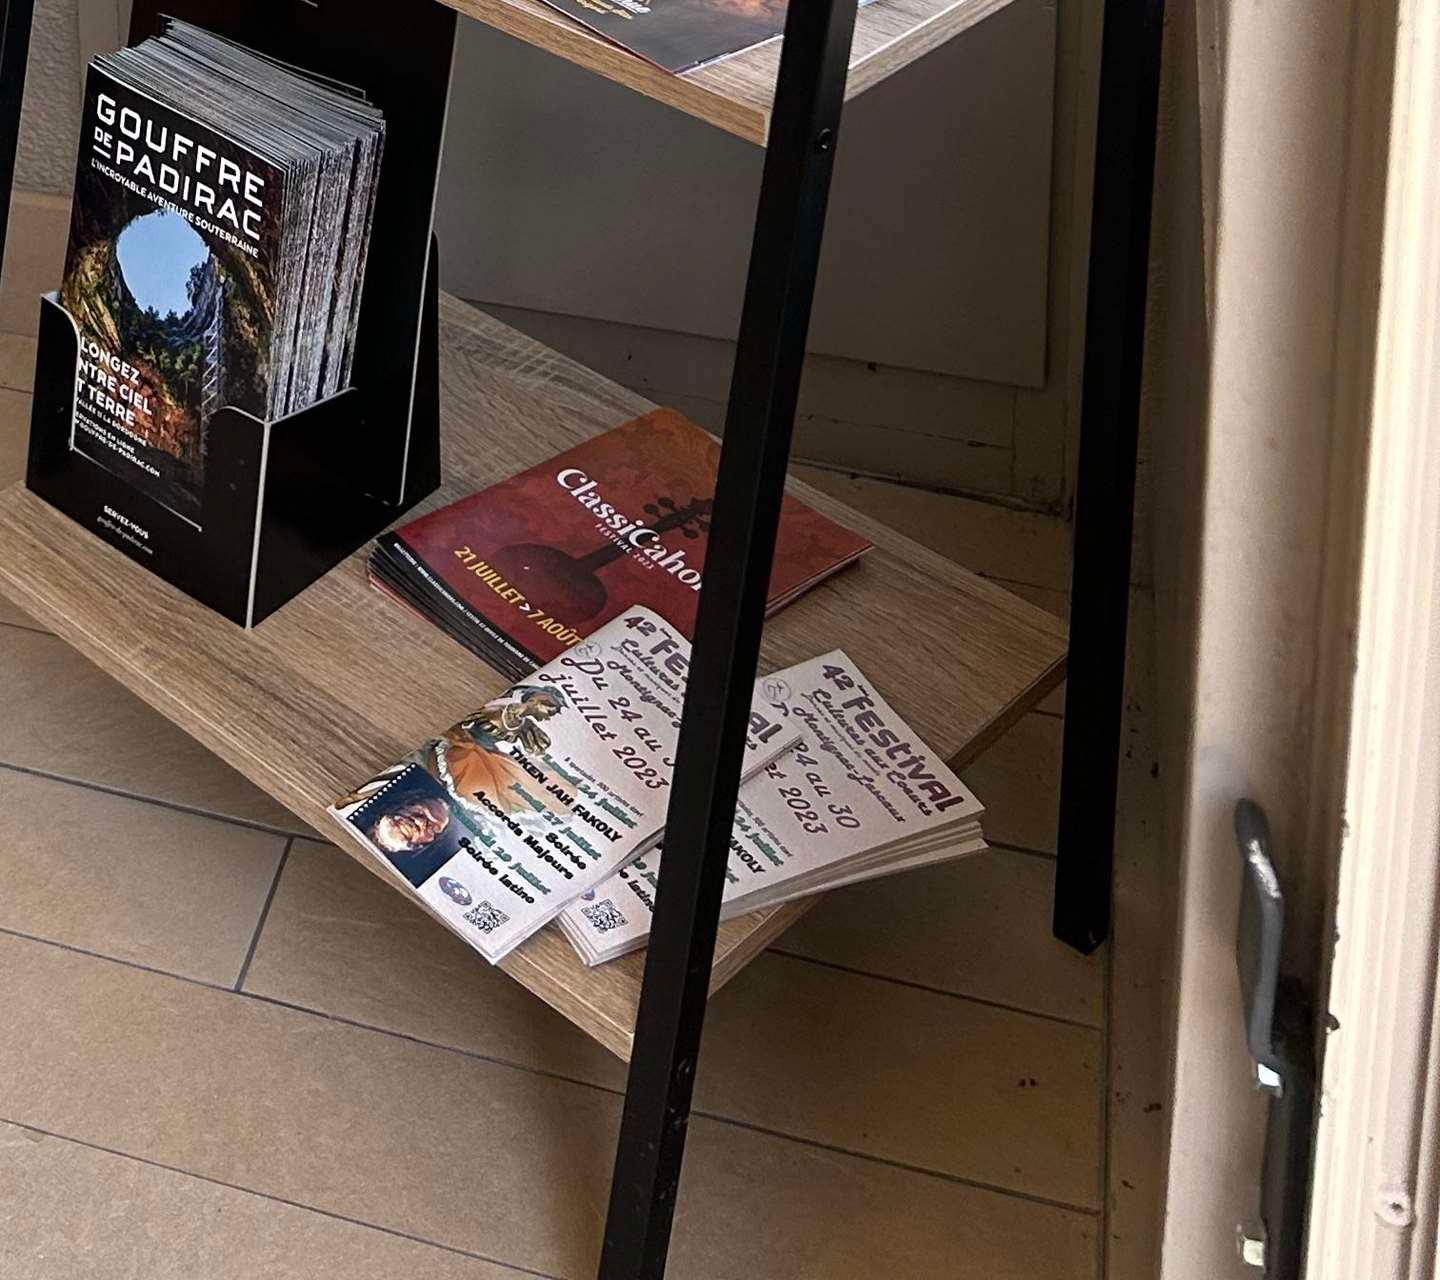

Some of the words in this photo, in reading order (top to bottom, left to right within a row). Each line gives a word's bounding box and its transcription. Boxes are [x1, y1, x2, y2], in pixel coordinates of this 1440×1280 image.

[94, 127, 112, 149] DE
[116, 140, 262, 241] PADIRAC
[96, 93, 265, 207] GOUFFRE
[91, 158, 147, 197] L'INCROYABLE
[147, 192, 194, 223] AVENTURE
[195, 216, 259, 259] SOUTERRAINE
[87, 385, 136, 427] TERRE
[119, 383, 152, 416] CIEL
[595, 523, 633, 554] FESTIVAL
[454, 545, 476, 563] 21
[467, 561, 527, 605] JUILLET
[528, 609, 543, 620] 7
[537, 617, 583, 647] AOÛT
[538, 674, 618, 741] juillet
[612, 746, 669, 790] 2023
[561, 657, 608, 691] Du
[608, 696, 643, 723] 24
[633, 726, 663, 752] au
[510, 746, 548, 784] TIKEN
[546, 784, 574, 806] JAH
[572, 804, 623, 842] FAKOLY
[792, 706, 906, 823] Montignac-Lascaux
[812, 688, 865, 746] Cultures
[864, 747, 889, 770] aux
[886, 770, 933, 817] Coeurs
[473, 790, 523, 836] Accords
[778, 787, 829, 835] 2023
[806, 772, 832, 798] au
[828, 804, 860, 830] 30
[457, 836, 498, 876] Soirée
[498, 874, 535, 904] latino
[545, 832, 587, 870] Soirée
